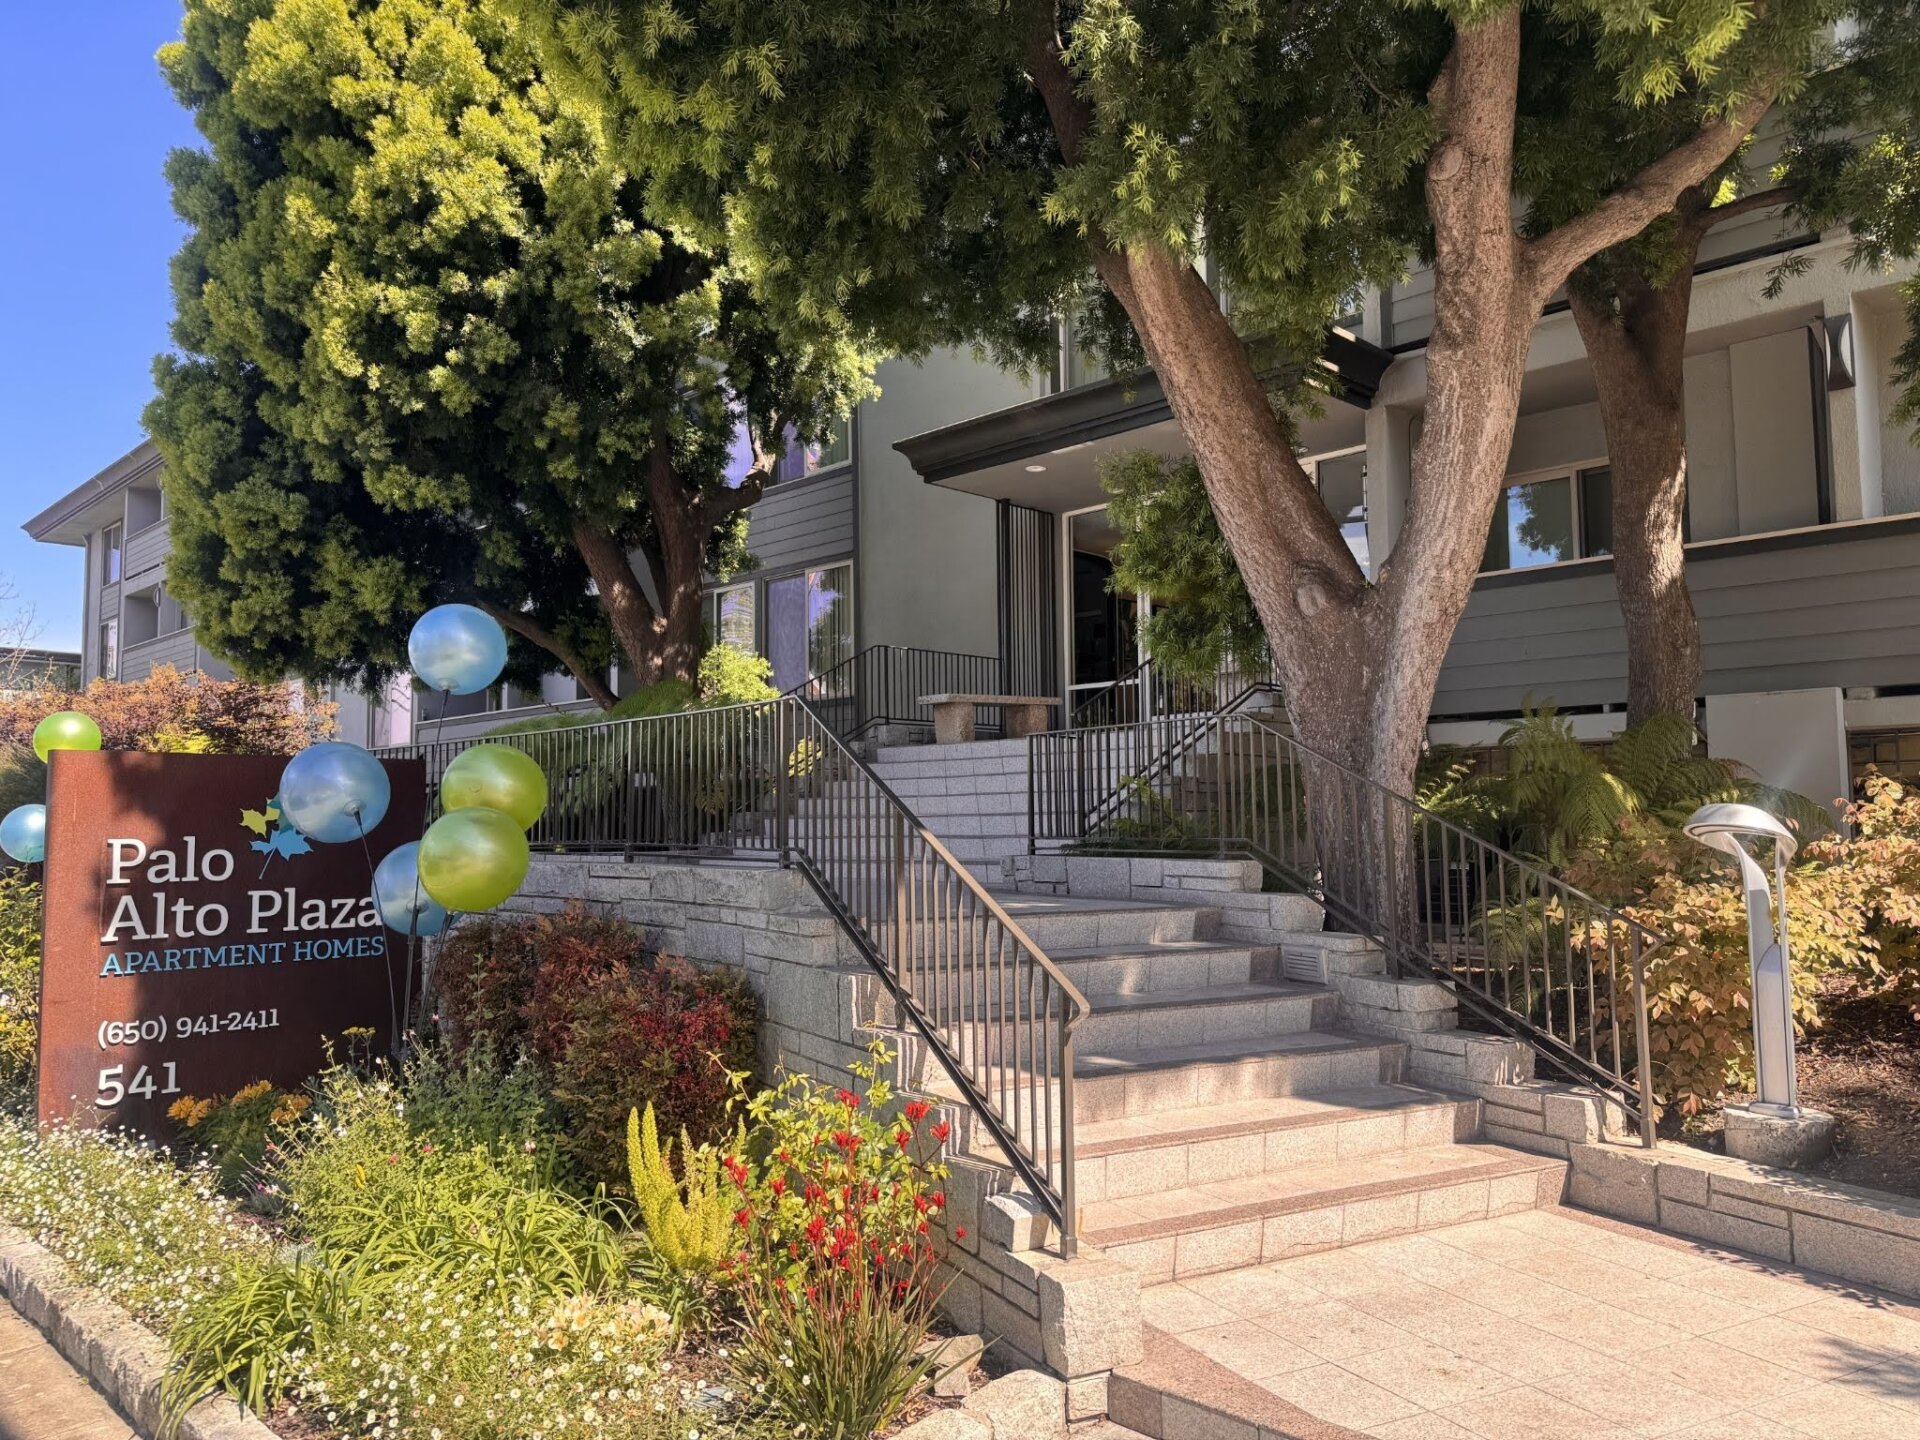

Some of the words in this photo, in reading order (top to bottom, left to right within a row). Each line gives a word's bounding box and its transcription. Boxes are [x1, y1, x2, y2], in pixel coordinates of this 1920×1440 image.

[107, 836, 235, 885] Palo
[101, 892, 229, 942] Alto
[246, 887, 382, 934] Plaza
[101, 942, 286, 977] APARTMENT
[292, 936, 385, 962] HOMES
[97, 1015, 168, 1049] (650)
[176, 1009, 280, 1037] 941-2411
[94, 1061, 181, 1106] 541
